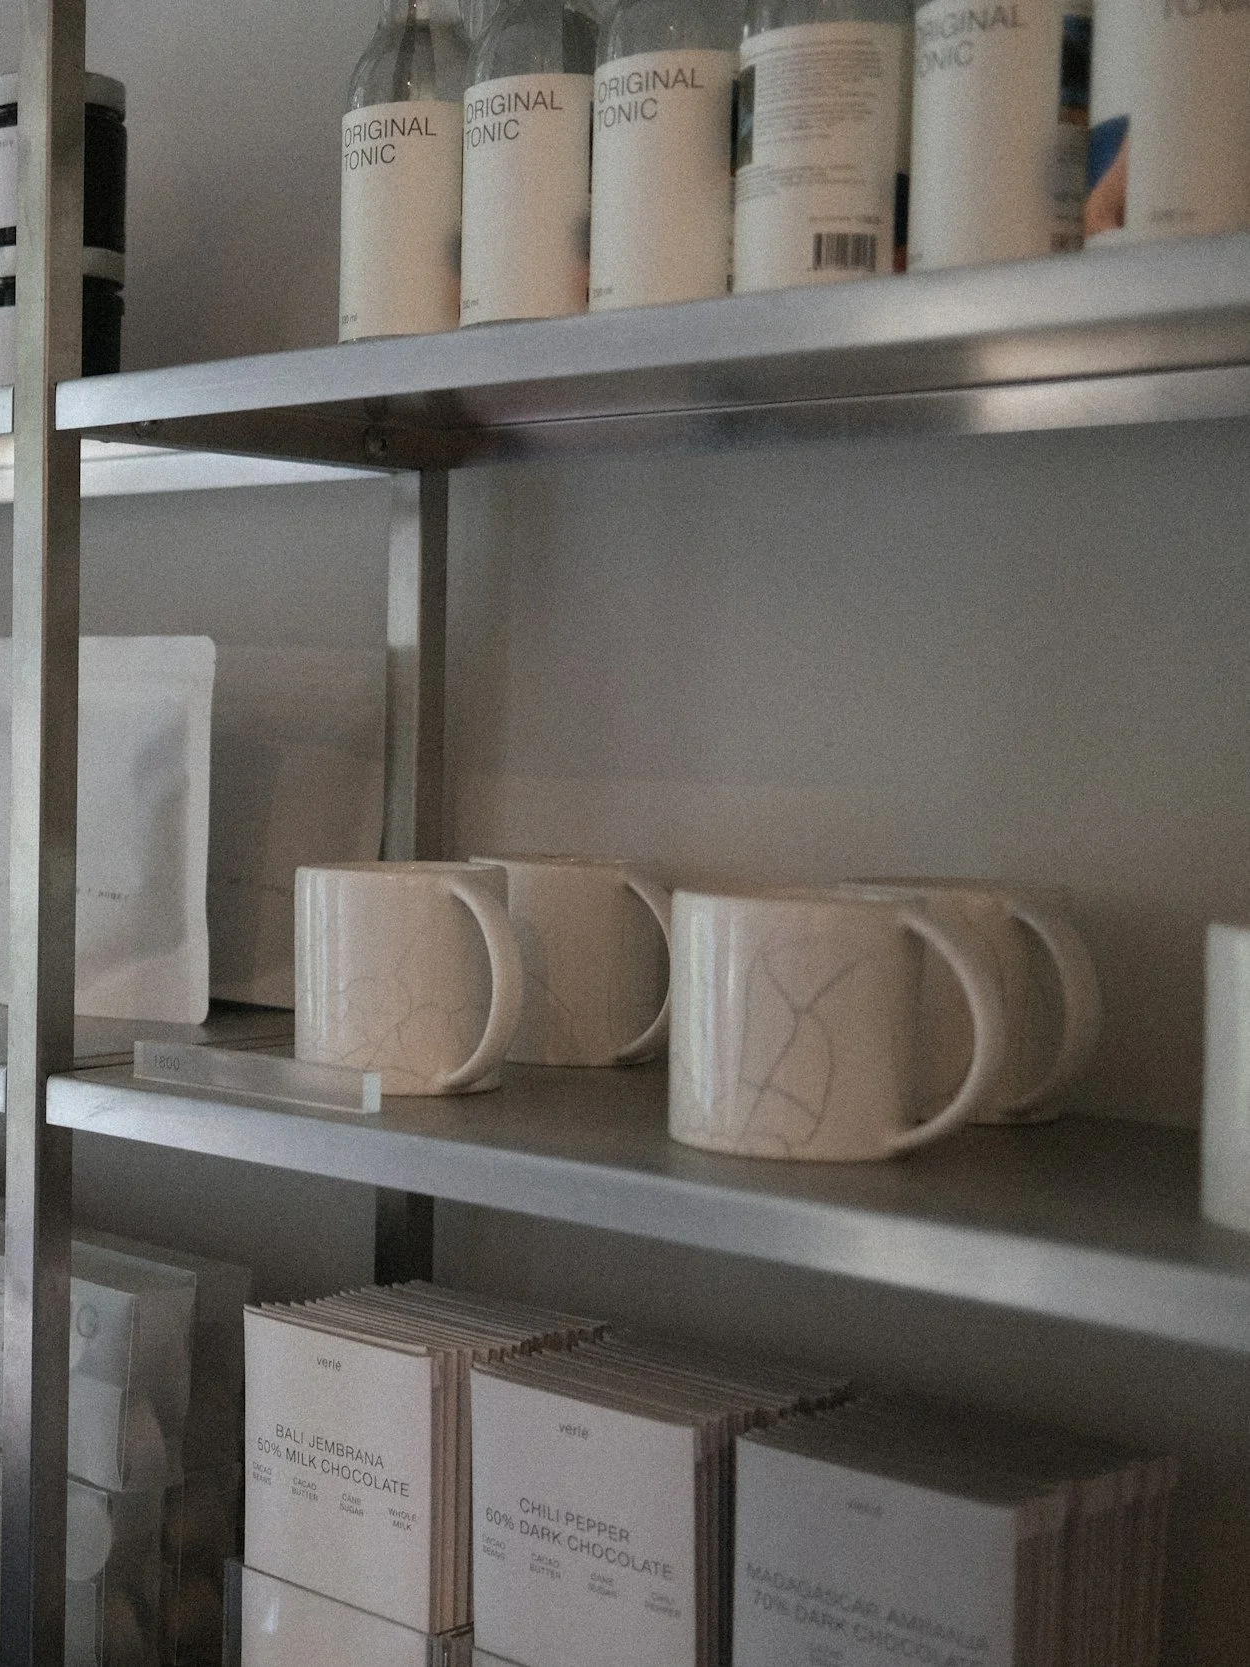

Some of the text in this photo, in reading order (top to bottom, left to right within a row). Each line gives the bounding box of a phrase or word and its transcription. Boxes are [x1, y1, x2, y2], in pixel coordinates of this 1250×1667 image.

[916, 3, 1029, 46] RIGINAL
[916, 40, 975, 79] ONIC
[598, 67, 705, 104] ORIGINAL
[465, 90, 564, 124] ORIGINAL
[597, 97, 659, 131] TONIC
[343, 117, 438, 148] ORIGINAL
[465, 119, 520, 150] TONIC
[343, 143, 396, 171] TONIC
[153, 1054, 180, 1072] 1800
[275, 1423, 385, 1470] BALI JEMBRANA
[285, 1447, 317, 1470] MILK
[320, 1458, 411, 1498] CHOCOLATE
[292, 1476, 317, 1491] CACAO
[387, 1507, 417, 1522] WHOLE
[392, 1519, 412, 1532] MILK
[518, 1496, 631, 1544] CHILI PEPPER
[485, 1506, 675, 1582] 60% DARK CHOCOLATE
